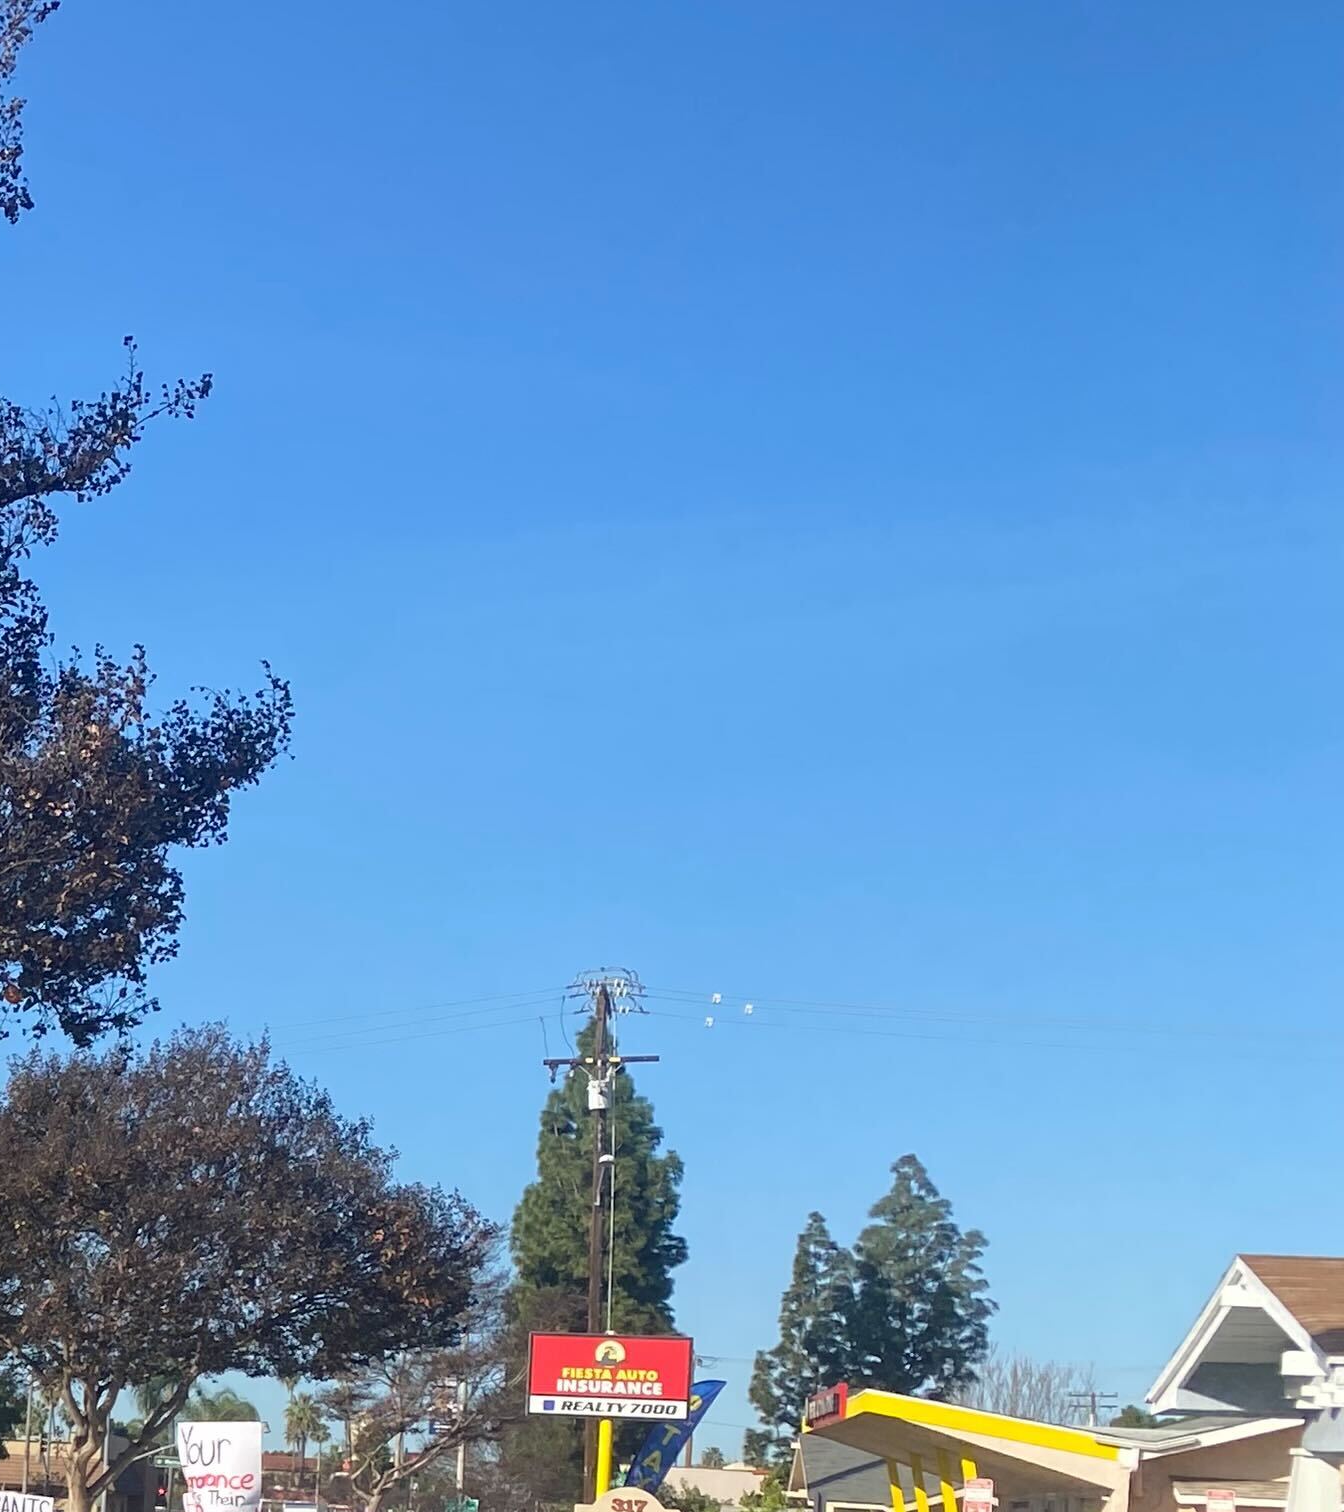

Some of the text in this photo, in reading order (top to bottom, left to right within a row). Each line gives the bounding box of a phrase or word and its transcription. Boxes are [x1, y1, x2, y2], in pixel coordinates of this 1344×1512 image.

[561, 1367, 659, 1381] FIESTA AUTO
[556, 1378, 664, 1396] INSURANCE
[561, 1401, 678, 1416] REALTY 7000
[180, 1424, 232, 1467] Your
